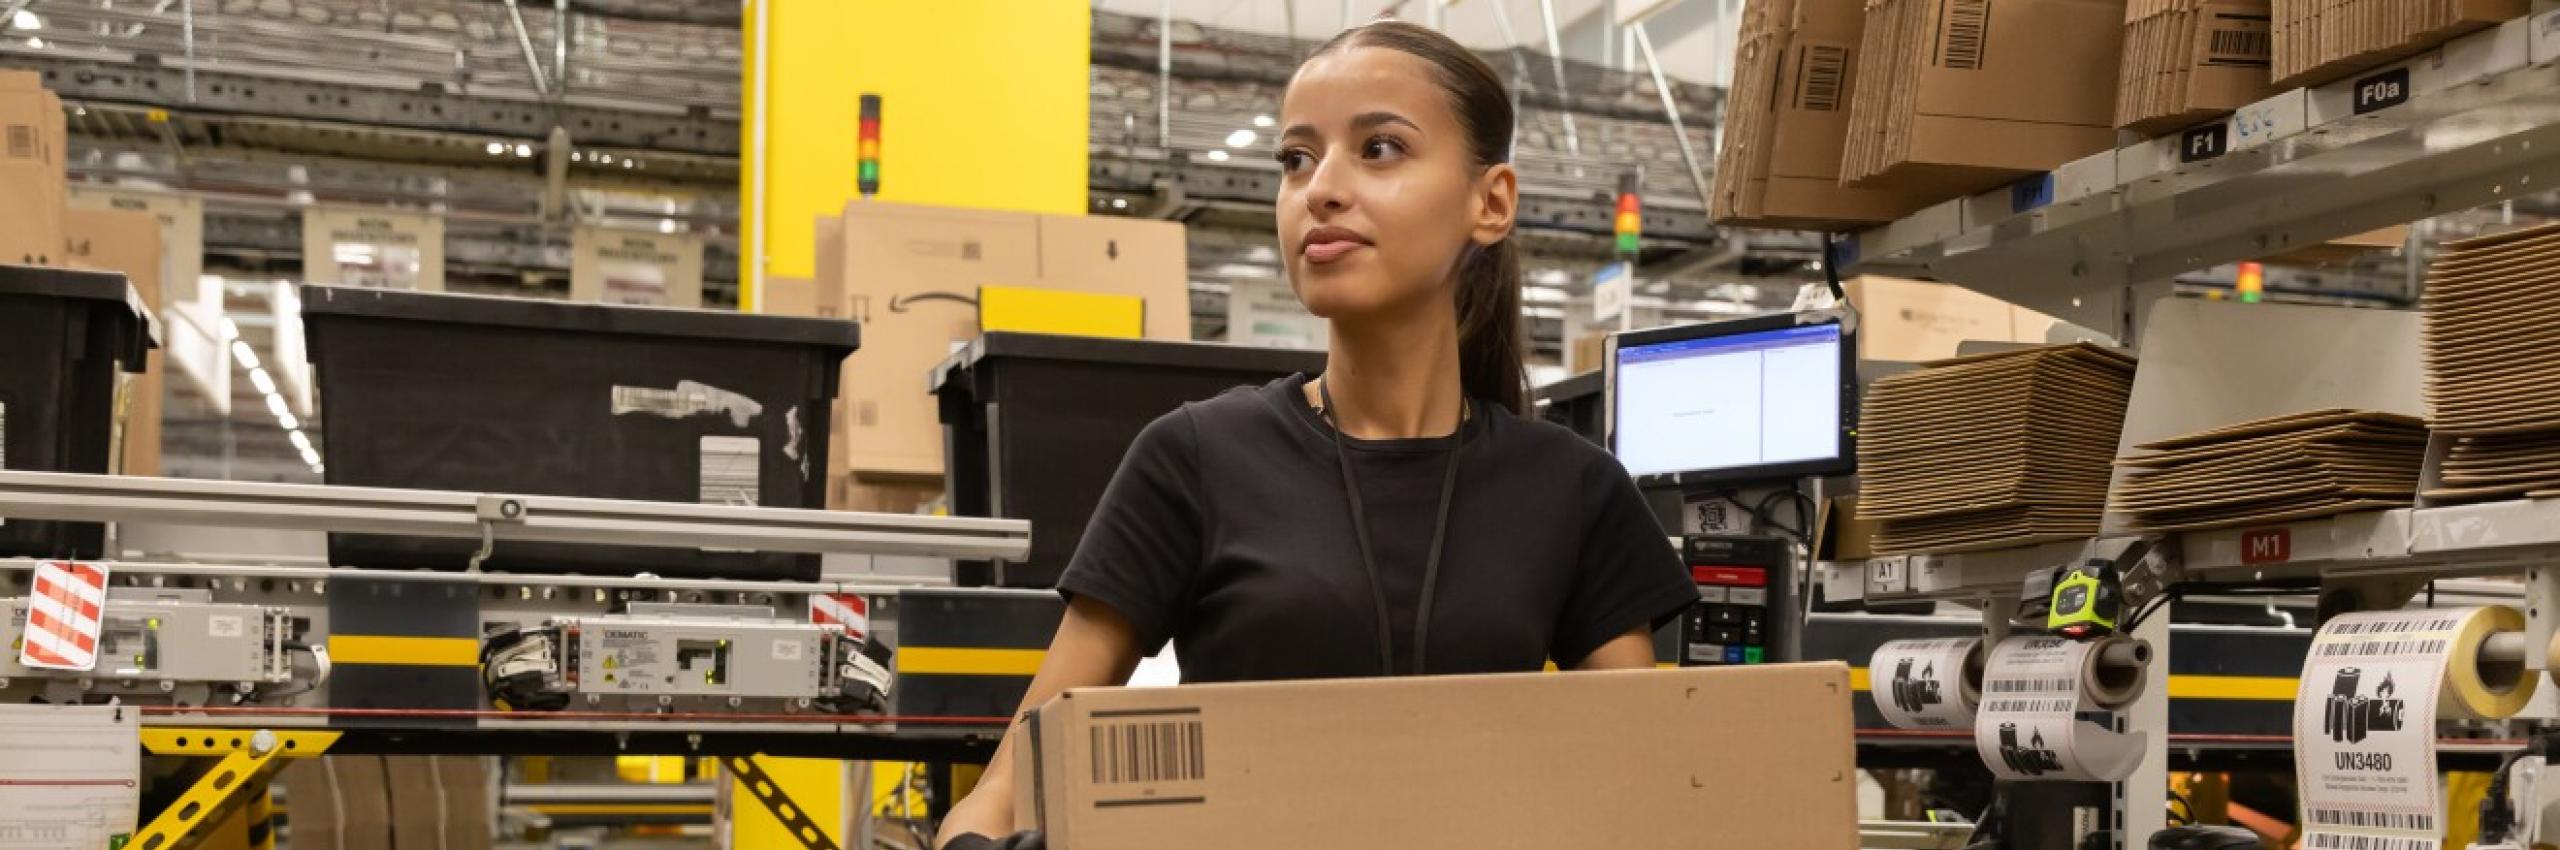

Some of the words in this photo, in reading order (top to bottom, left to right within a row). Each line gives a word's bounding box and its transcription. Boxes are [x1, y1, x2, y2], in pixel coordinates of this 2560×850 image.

[2361, 82, 2400, 105] F0a
[2192, 131, 2214, 155] F1
[2252, 534, 2280, 557] M1
[1878, 561, 1893, 578] A1
[2334, 750, 2392, 772] UN3480
